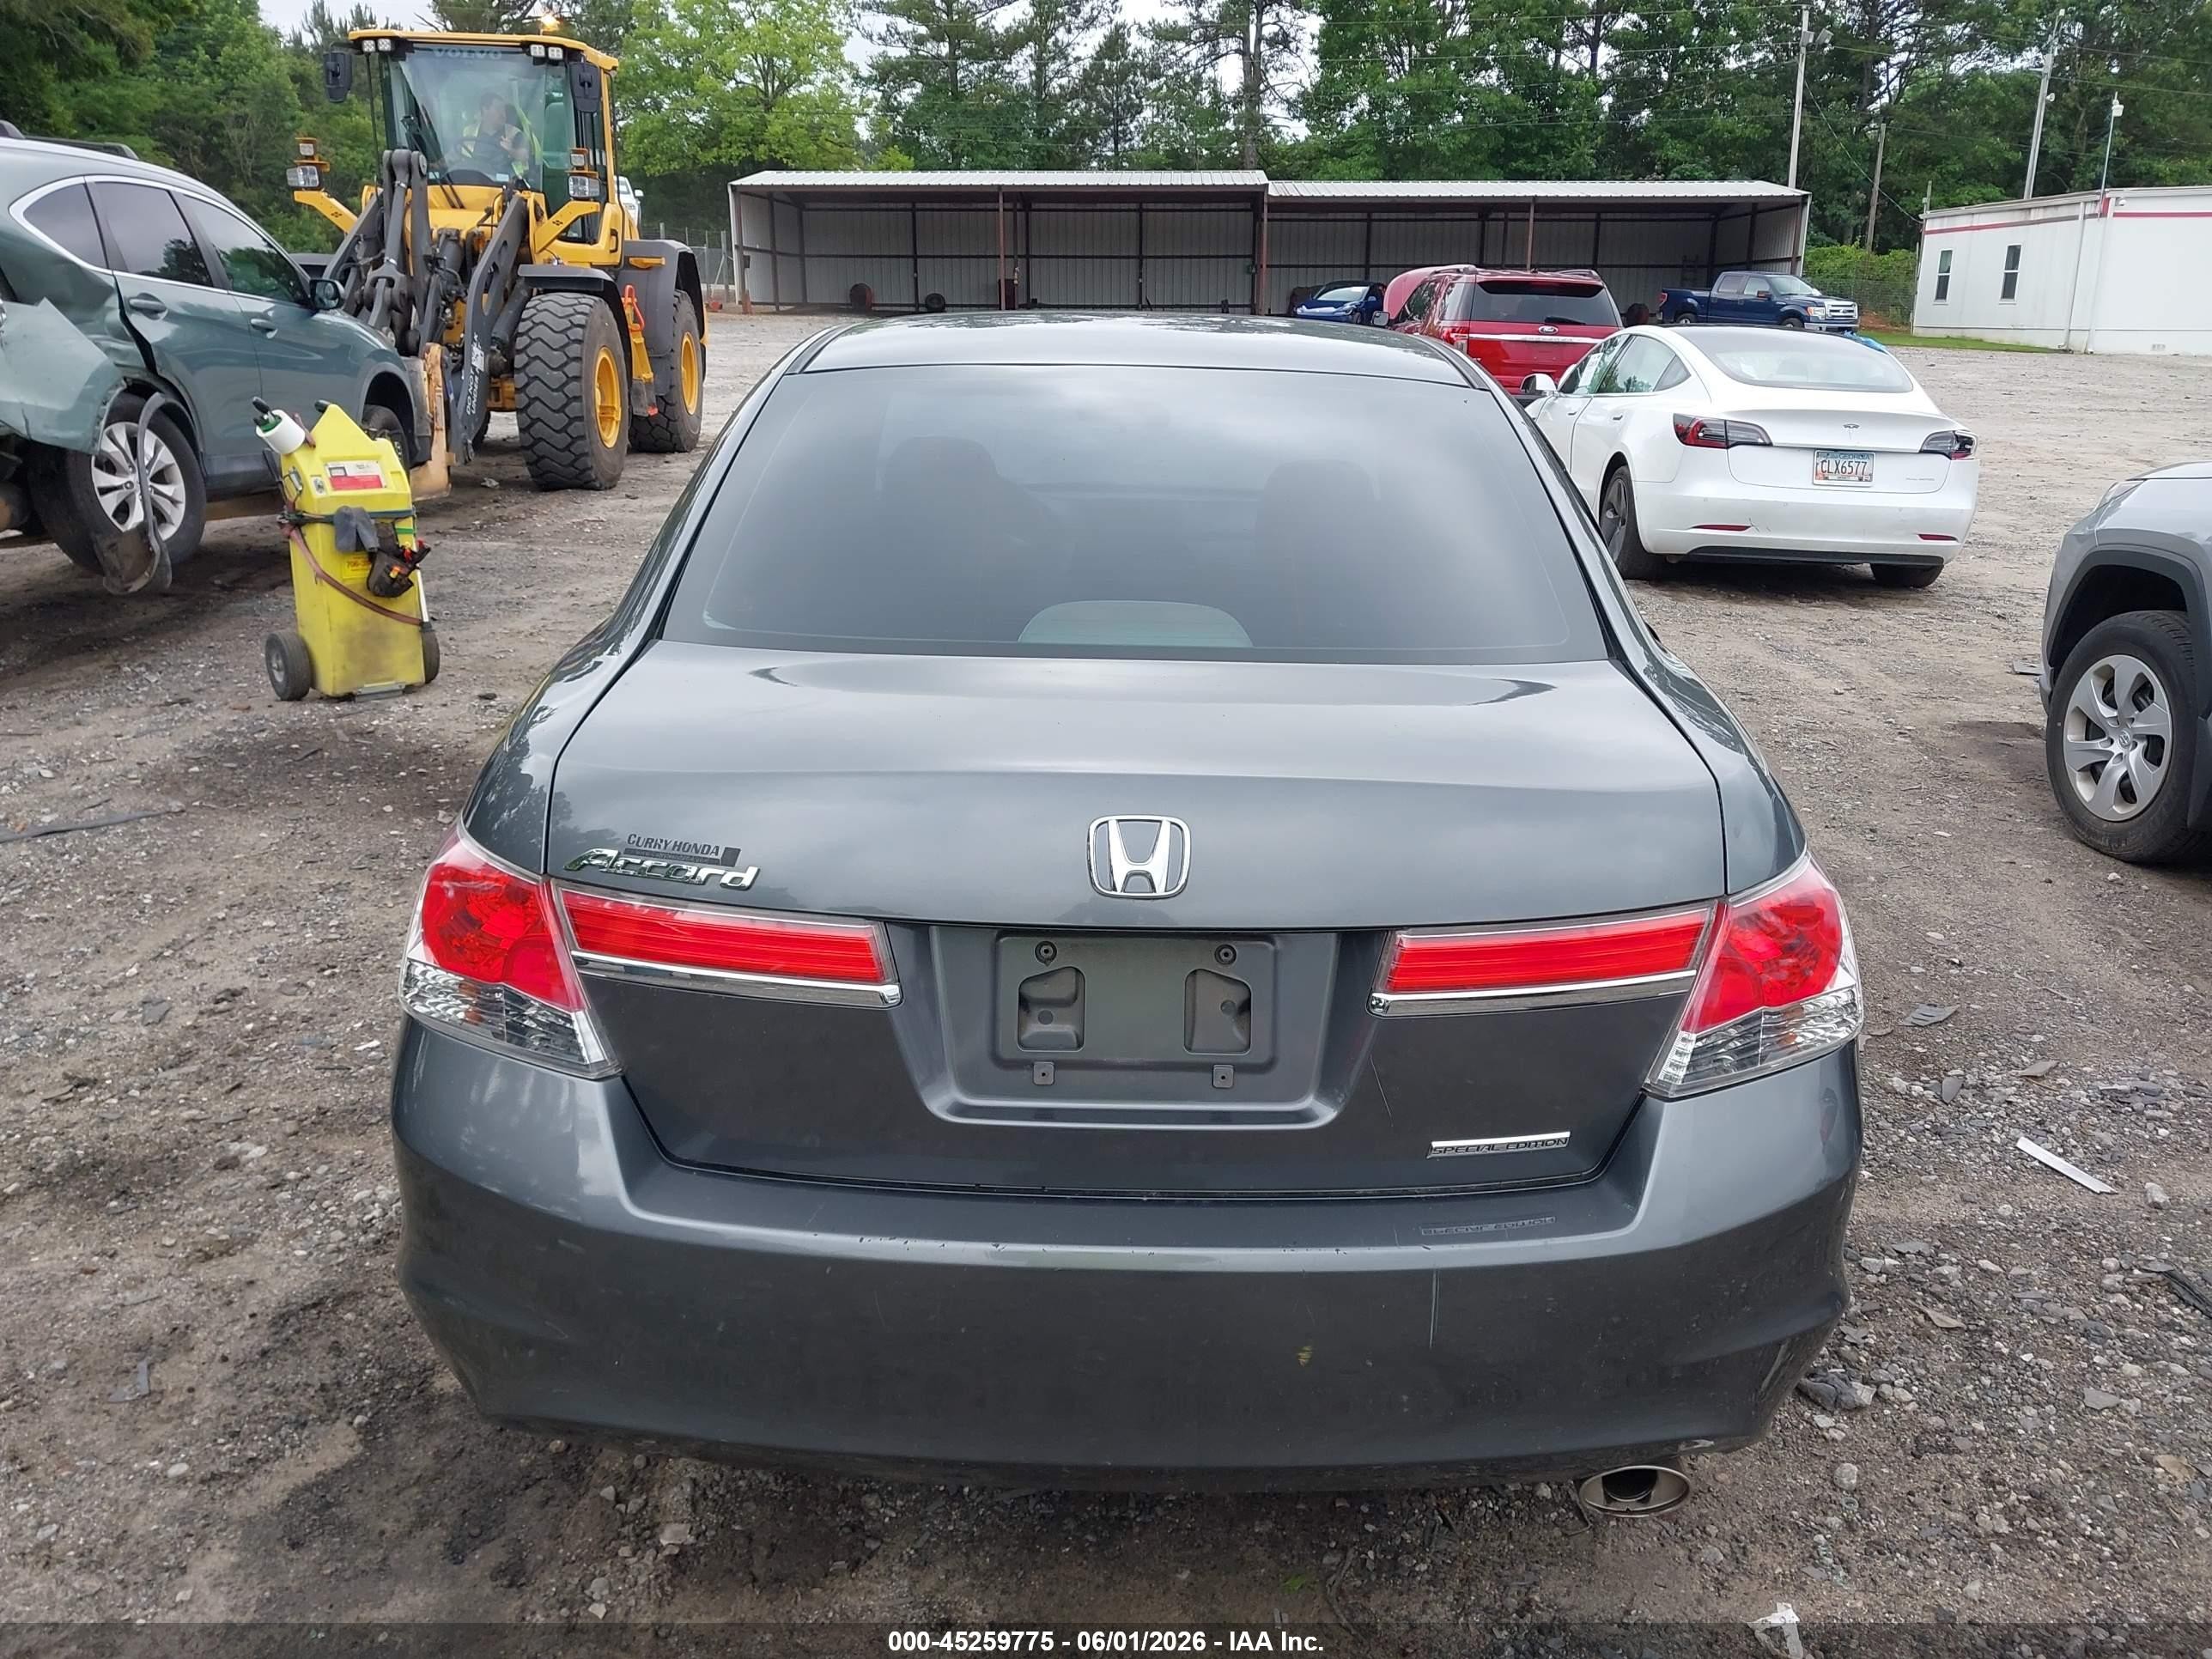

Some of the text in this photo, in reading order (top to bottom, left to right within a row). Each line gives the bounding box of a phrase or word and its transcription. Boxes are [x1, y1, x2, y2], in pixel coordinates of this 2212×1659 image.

[434, 48, 502, 59] VOLVO
[1820, 459, 1868, 476] CLX6577
[627, 833, 672, 851] CURRY
[672, 840, 720, 857] HONDA
[562, 847, 761, 891] Accord
[1431, 1138, 1569, 1155] SPECIAL EDITION
